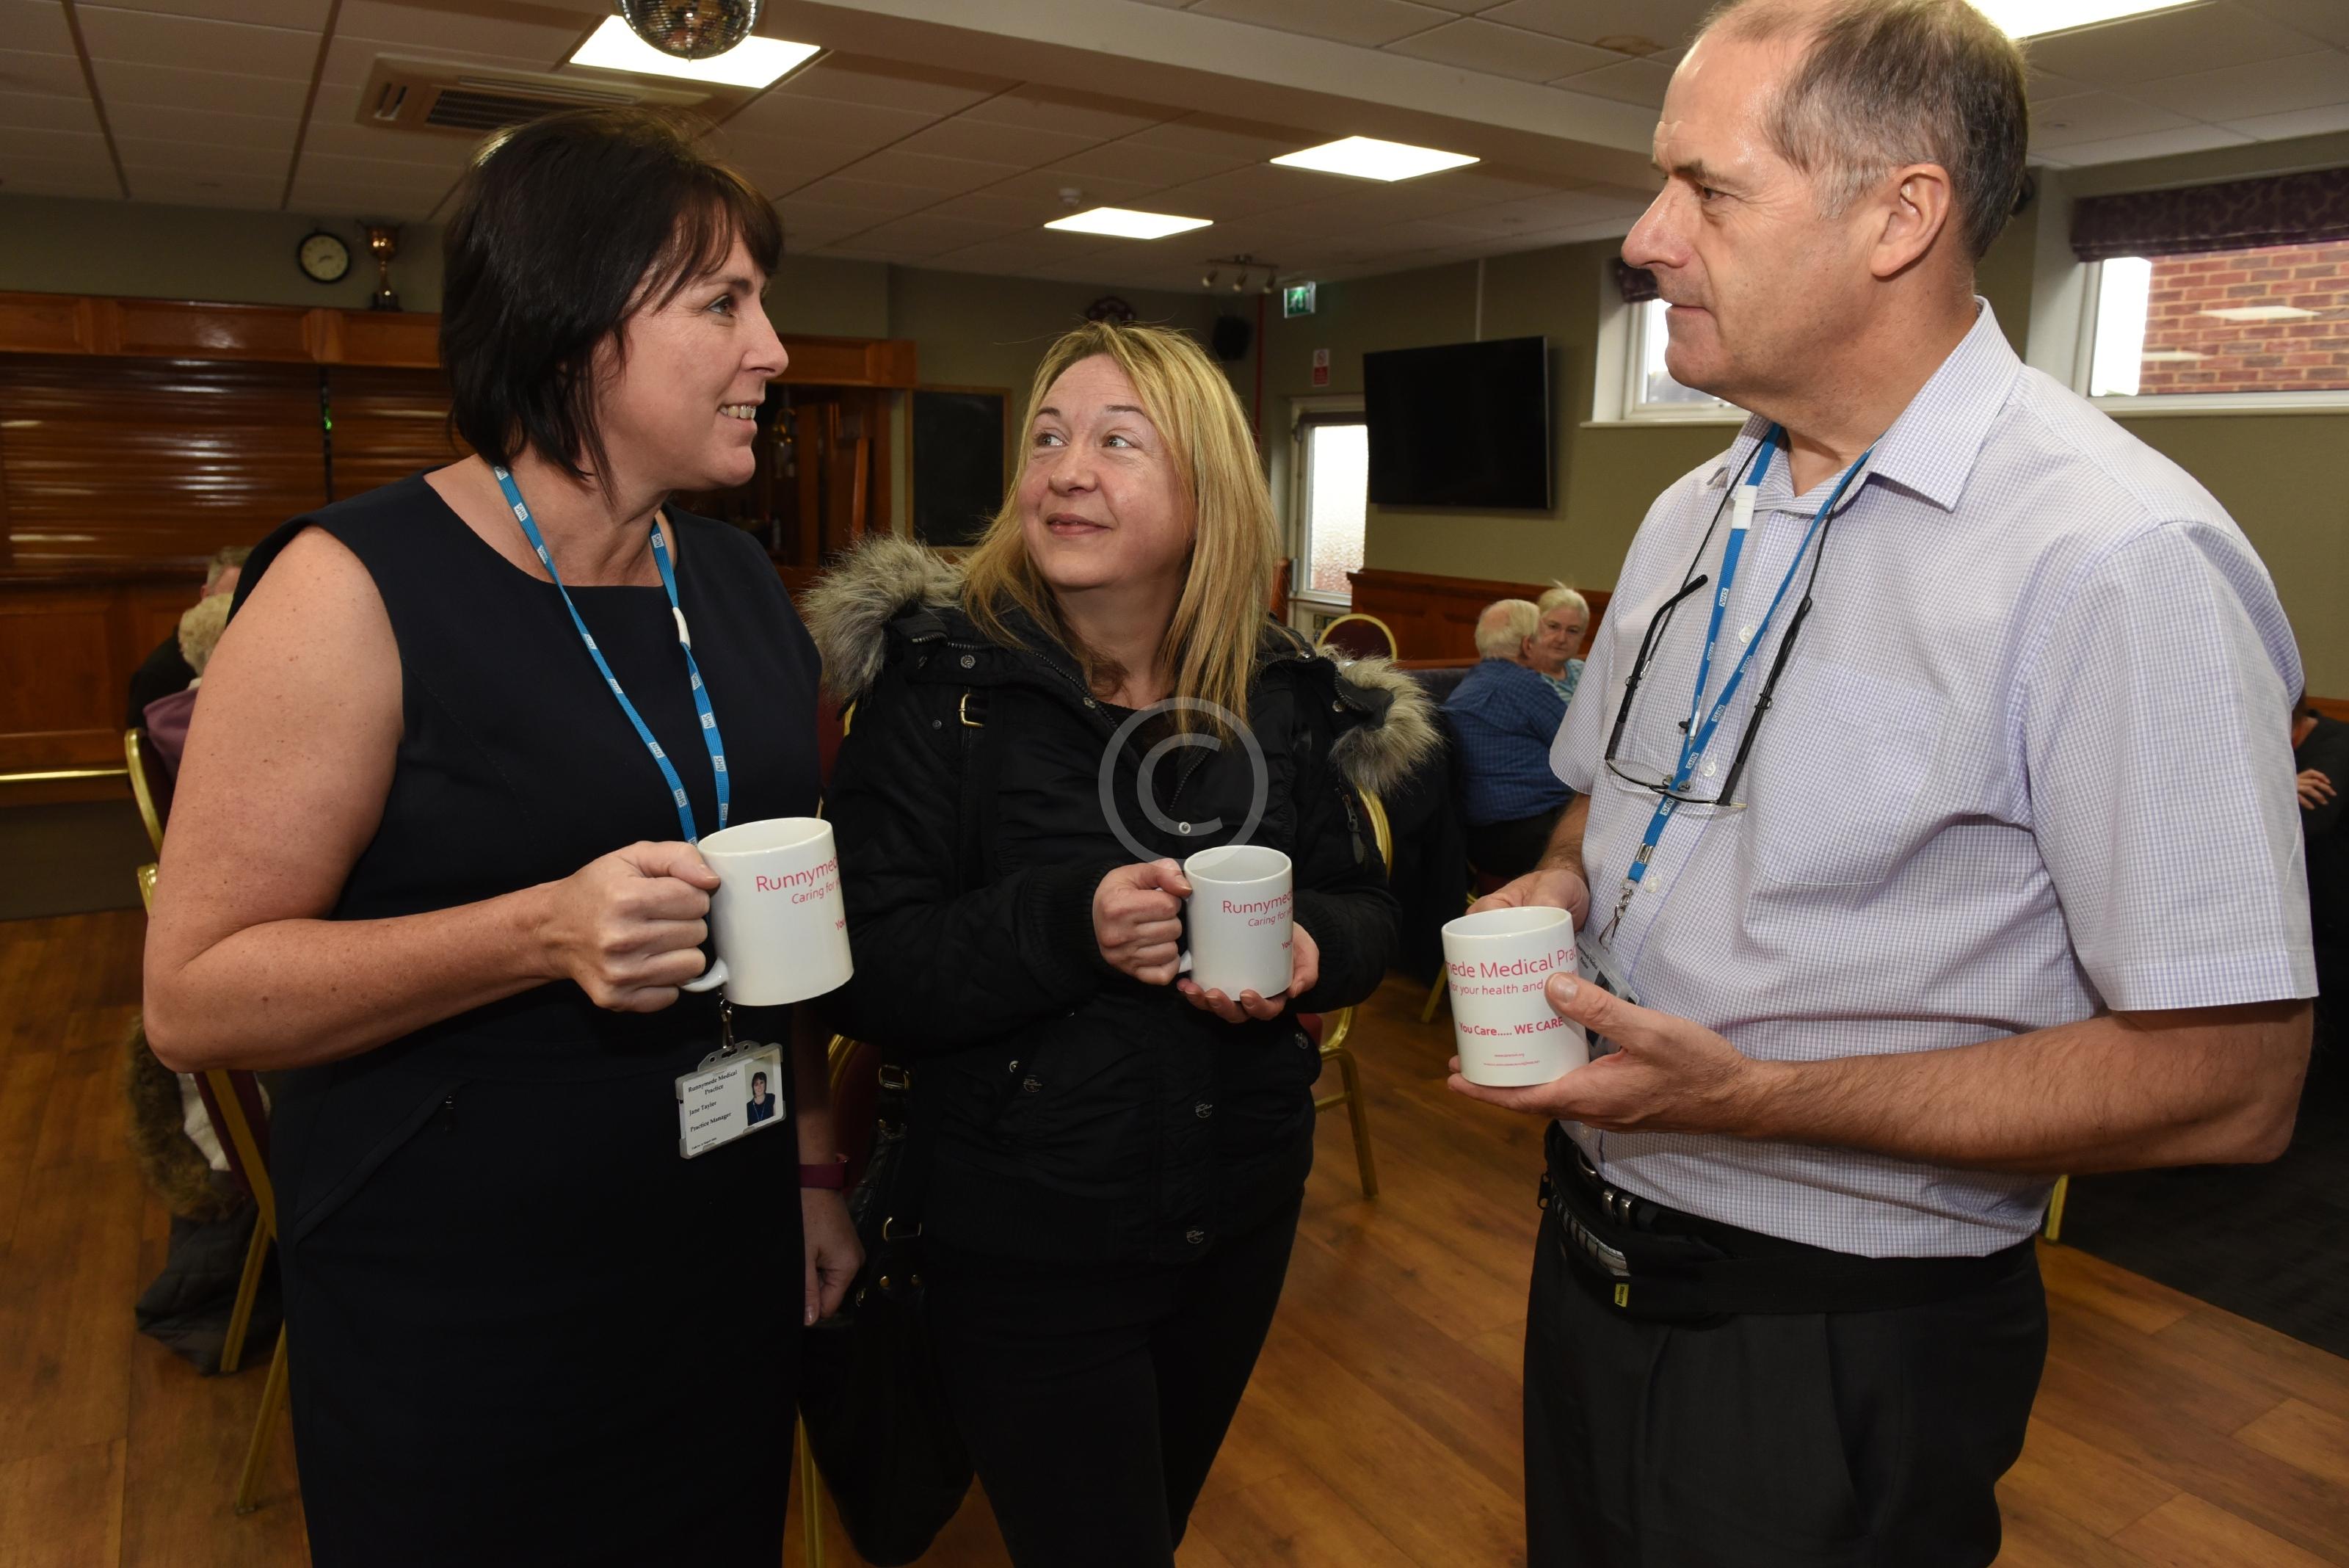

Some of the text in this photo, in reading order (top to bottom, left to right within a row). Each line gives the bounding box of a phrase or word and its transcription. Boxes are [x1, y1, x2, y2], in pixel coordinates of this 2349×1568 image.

[515, 503, 527, 520] NHS
[653, 534, 664, 547] NHS
[1719, 589, 1729, 606] NHS
[691, 673, 701, 689] NHS
[702, 713, 715, 727] NHS
[1712, 705, 1724, 722] NHS
[650, 742, 664, 758] NHS
[714, 756, 725, 770] NHS
[1686, 753, 1699, 769] NHS
[675, 789, 686, 806] NHS
[1660, 799, 1674, 816] NHS
[791, 888, 824, 904] Caring
[826, 881, 835, 893] for
[1222, 886, 1293, 915] Runnymed
[1248, 915, 1276, 926] Caring
[1278, 910, 1286, 920] for
[1480, 953, 1553, 978] Medical
[1460, 985, 1479, 996] your
[1482, 983, 1518, 995] health
[1522, 979, 1543, 992] and
[1459, 1021, 1473, 1034] You
[1514, 1023, 1533, 1034] WE
[1536, 1017, 1563, 1031] CARE
[689, 1070, 738, 1092] Runnymede Medical
[705, 1084, 724, 1095] Practice
[689, 1101, 716, 1117] Jane Taylor
[691, 1112, 732, 1132] Practice Manager
